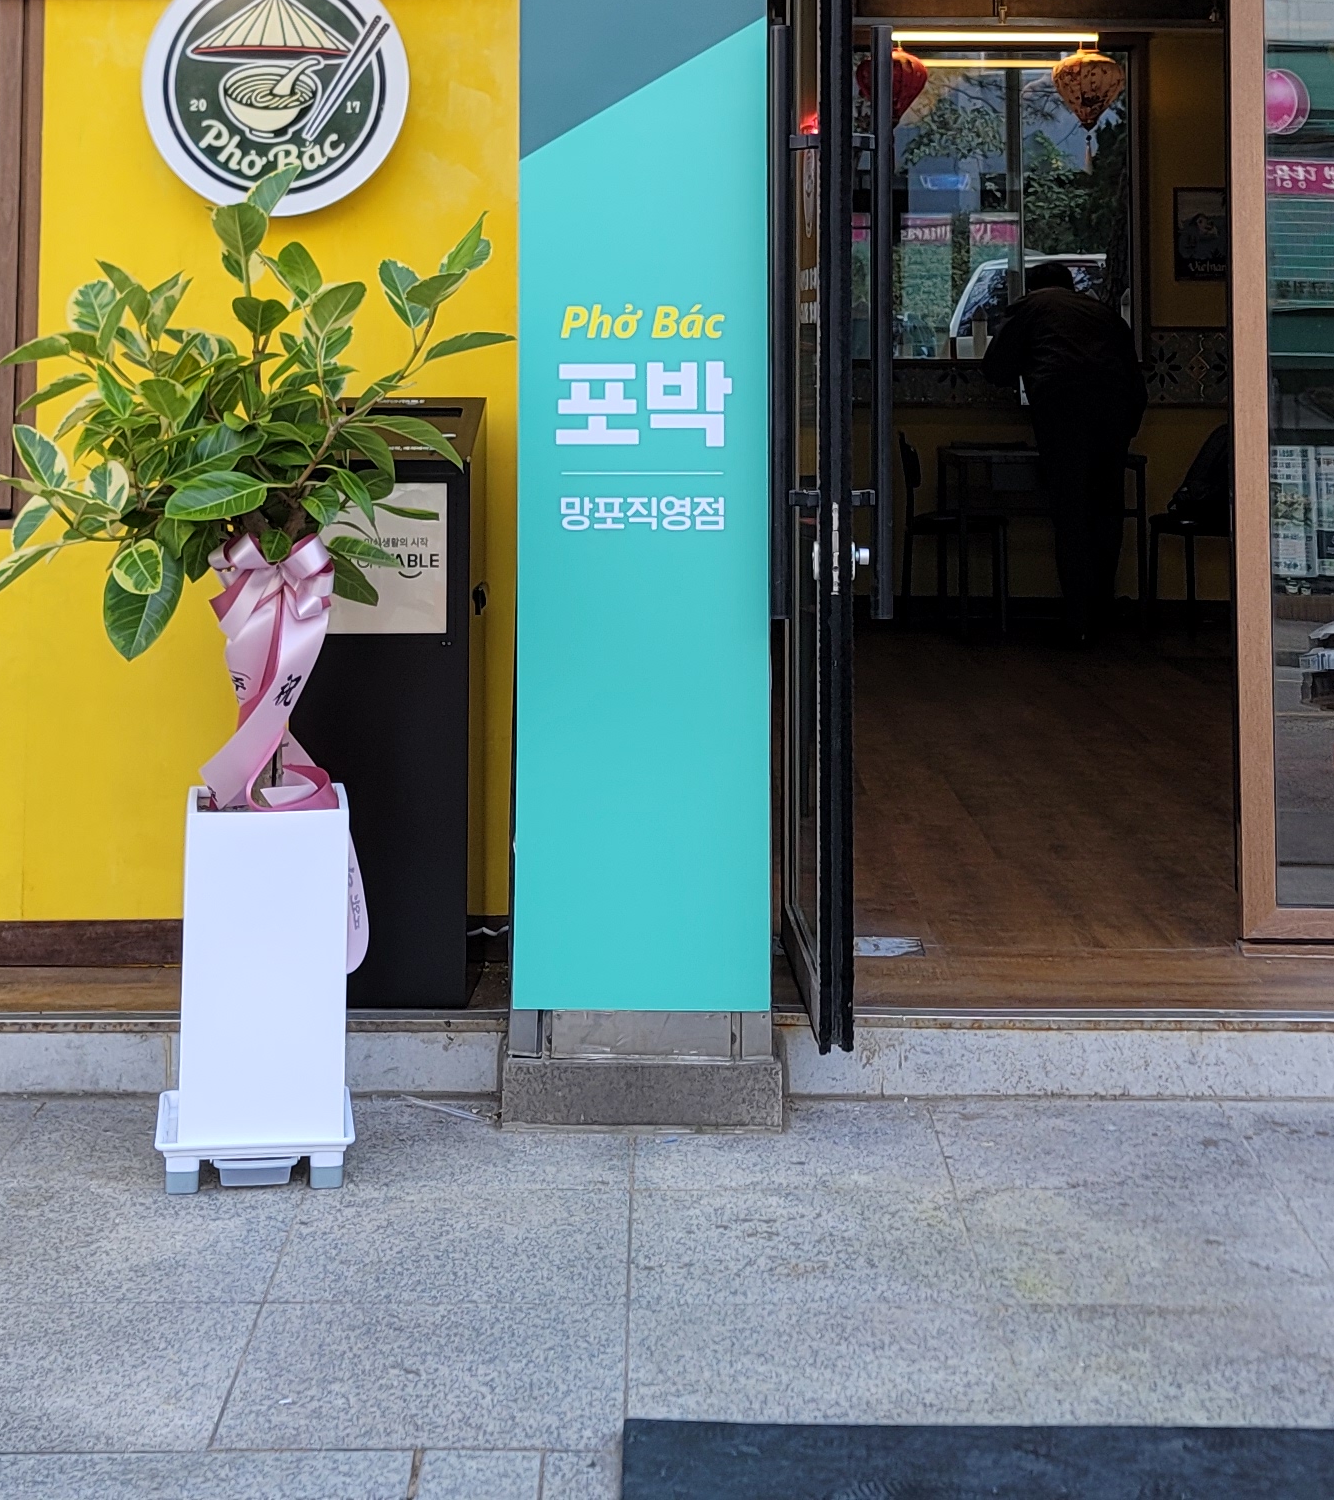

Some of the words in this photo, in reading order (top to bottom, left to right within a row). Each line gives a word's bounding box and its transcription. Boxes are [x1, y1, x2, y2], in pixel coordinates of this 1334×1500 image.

[189, 99, 207, 111] 20
[345, 102, 360, 113] 17
[561, 304, 643, 339] Phở
[651, 304, 725, 339] Bác
[556, 361, 732, 446] 포박
[560, 496, 725, 531] 망포직영점
